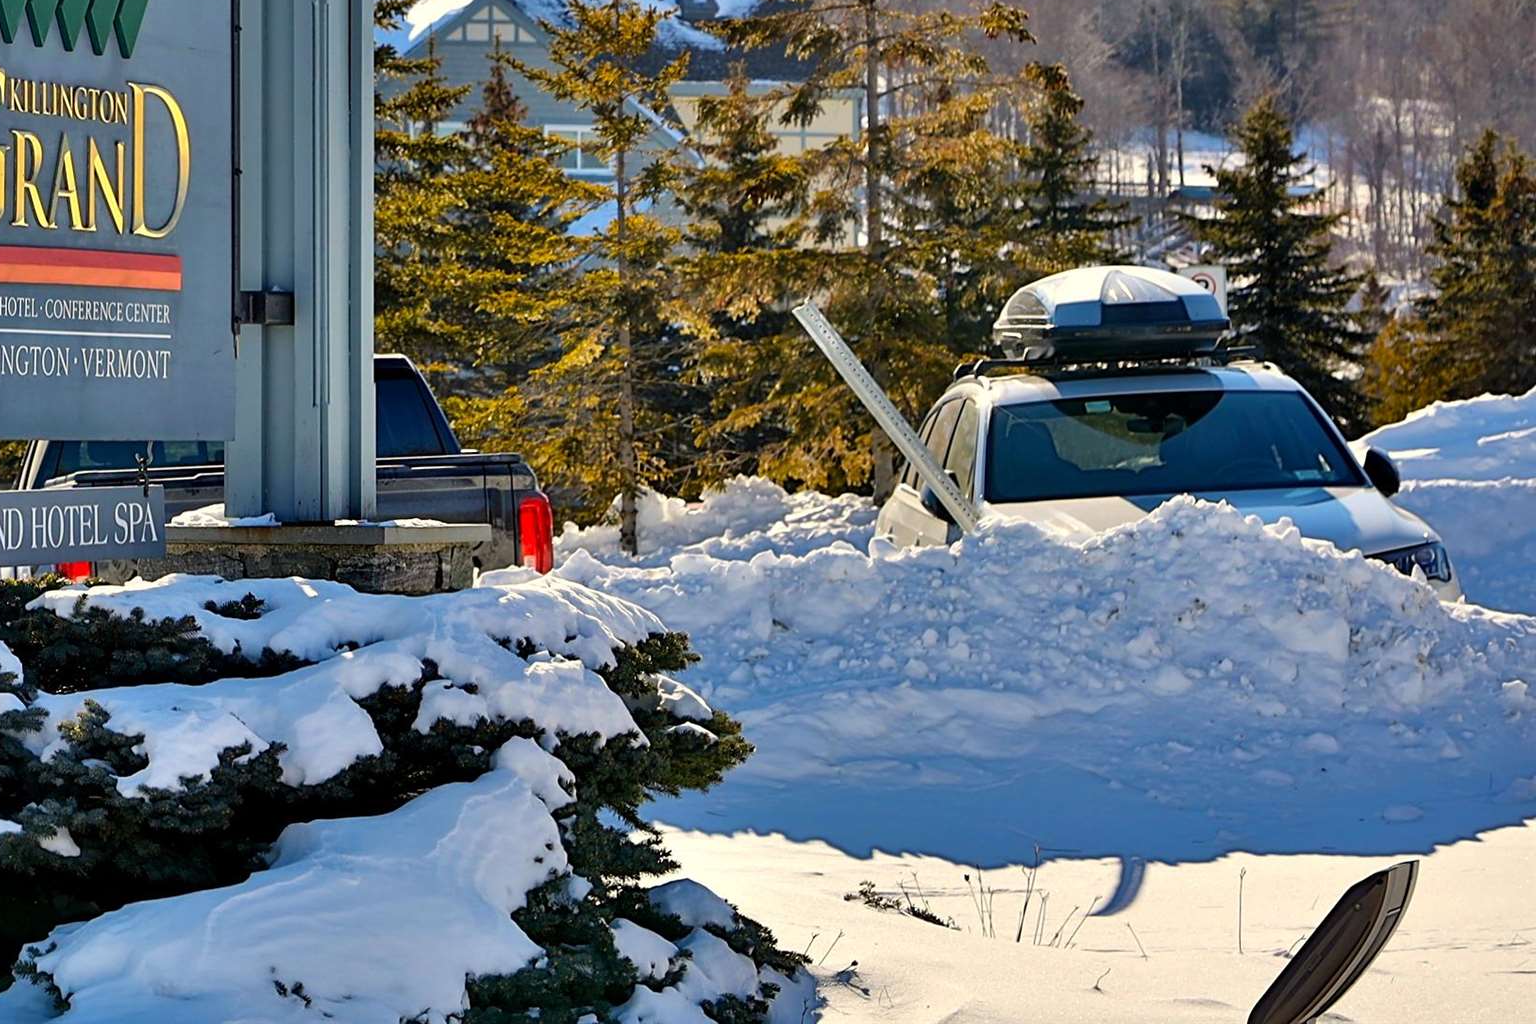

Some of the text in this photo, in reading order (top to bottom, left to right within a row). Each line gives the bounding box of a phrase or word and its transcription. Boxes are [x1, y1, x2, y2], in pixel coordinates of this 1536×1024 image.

[9, 77, 129, 125] KILLINGTON
[0, 295, 38, 318] HOTEL
[44, 298, 124, 322] CONFERENCE
[125, 302, 171, 324] CENTER
[80, 347, 172, 379] VERMONT
[31, 503, 108, 550] HOTEL
[113, 501, 159, 545] SPA
